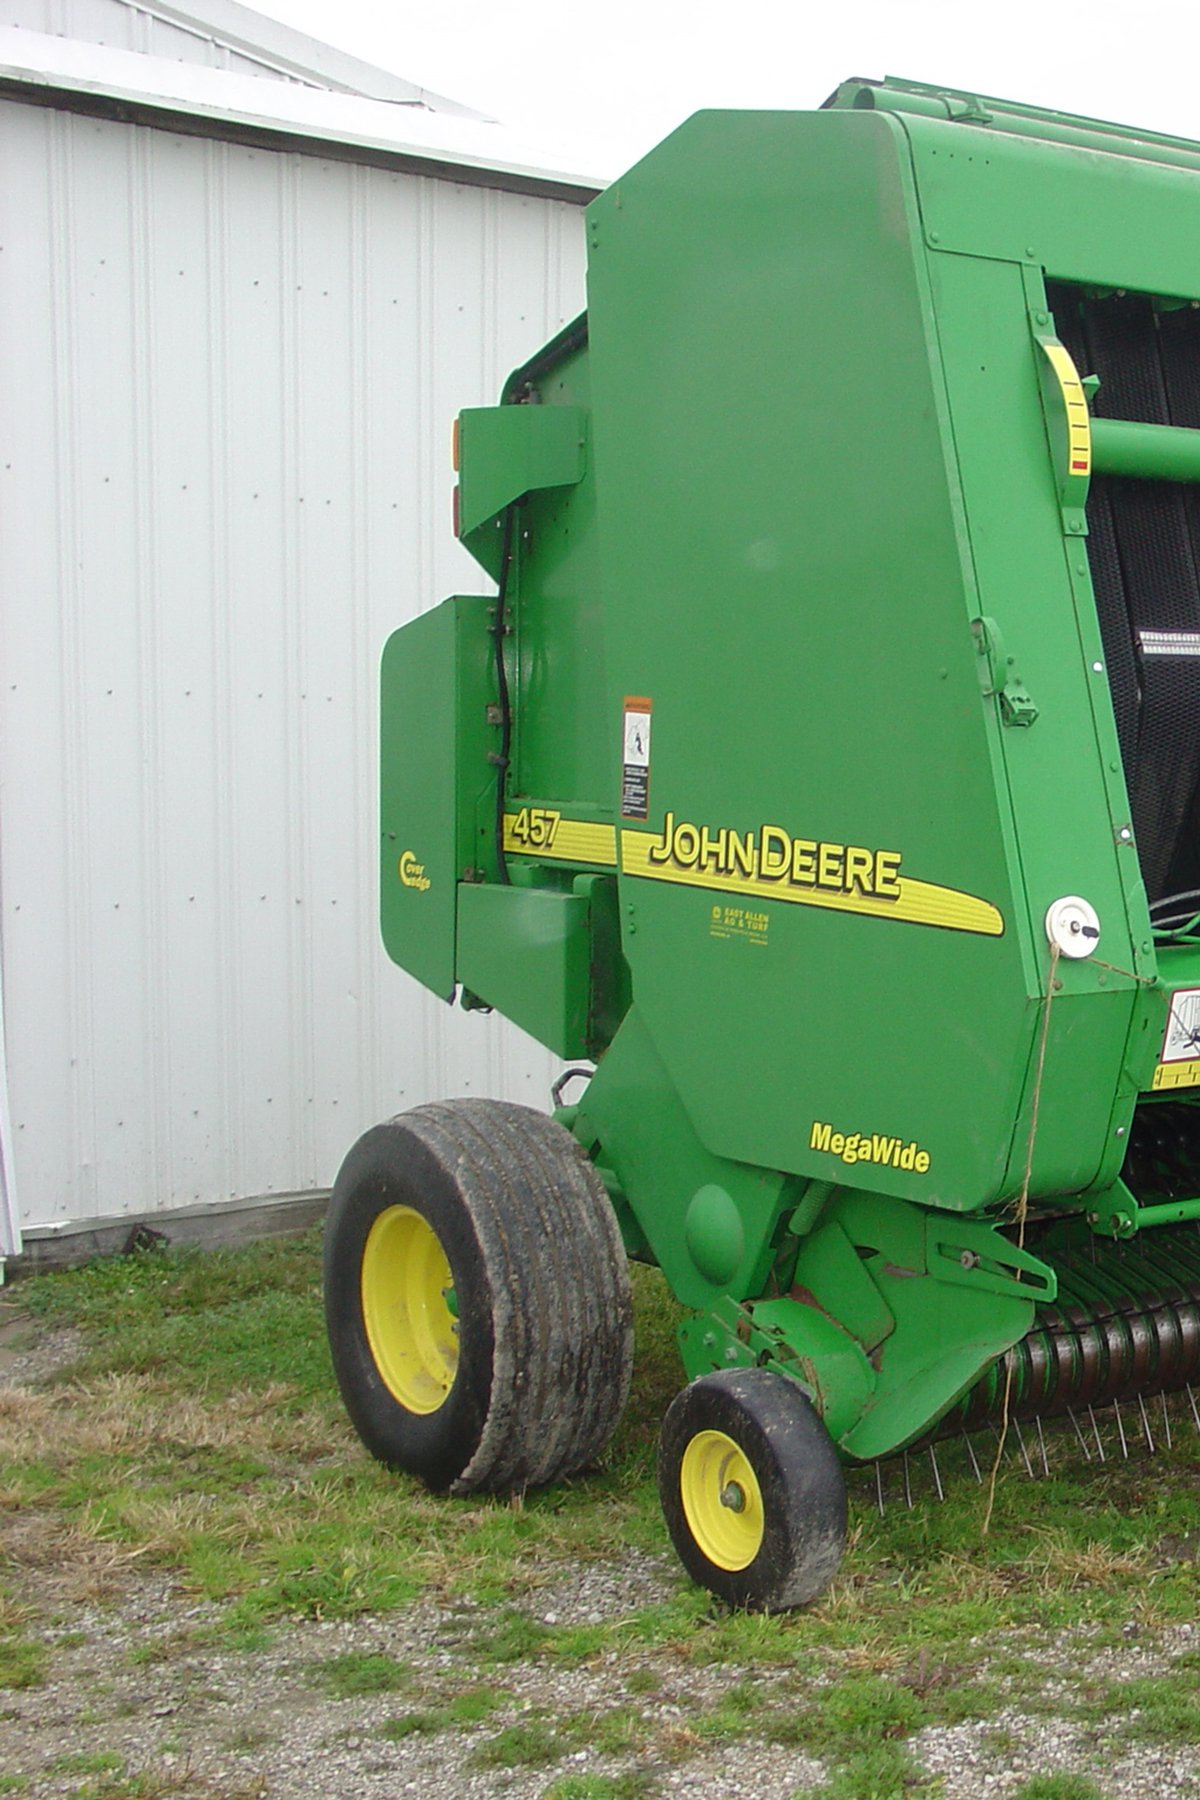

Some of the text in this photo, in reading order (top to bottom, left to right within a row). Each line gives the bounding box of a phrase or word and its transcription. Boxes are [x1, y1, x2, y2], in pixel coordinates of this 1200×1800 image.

[511, 807, 561, 847] 457
[724, 907, 768, 921] EAST ALLEN
[747, 921, 768, 931] TURF
[810, 1121, 931, 1173] MegaWide
